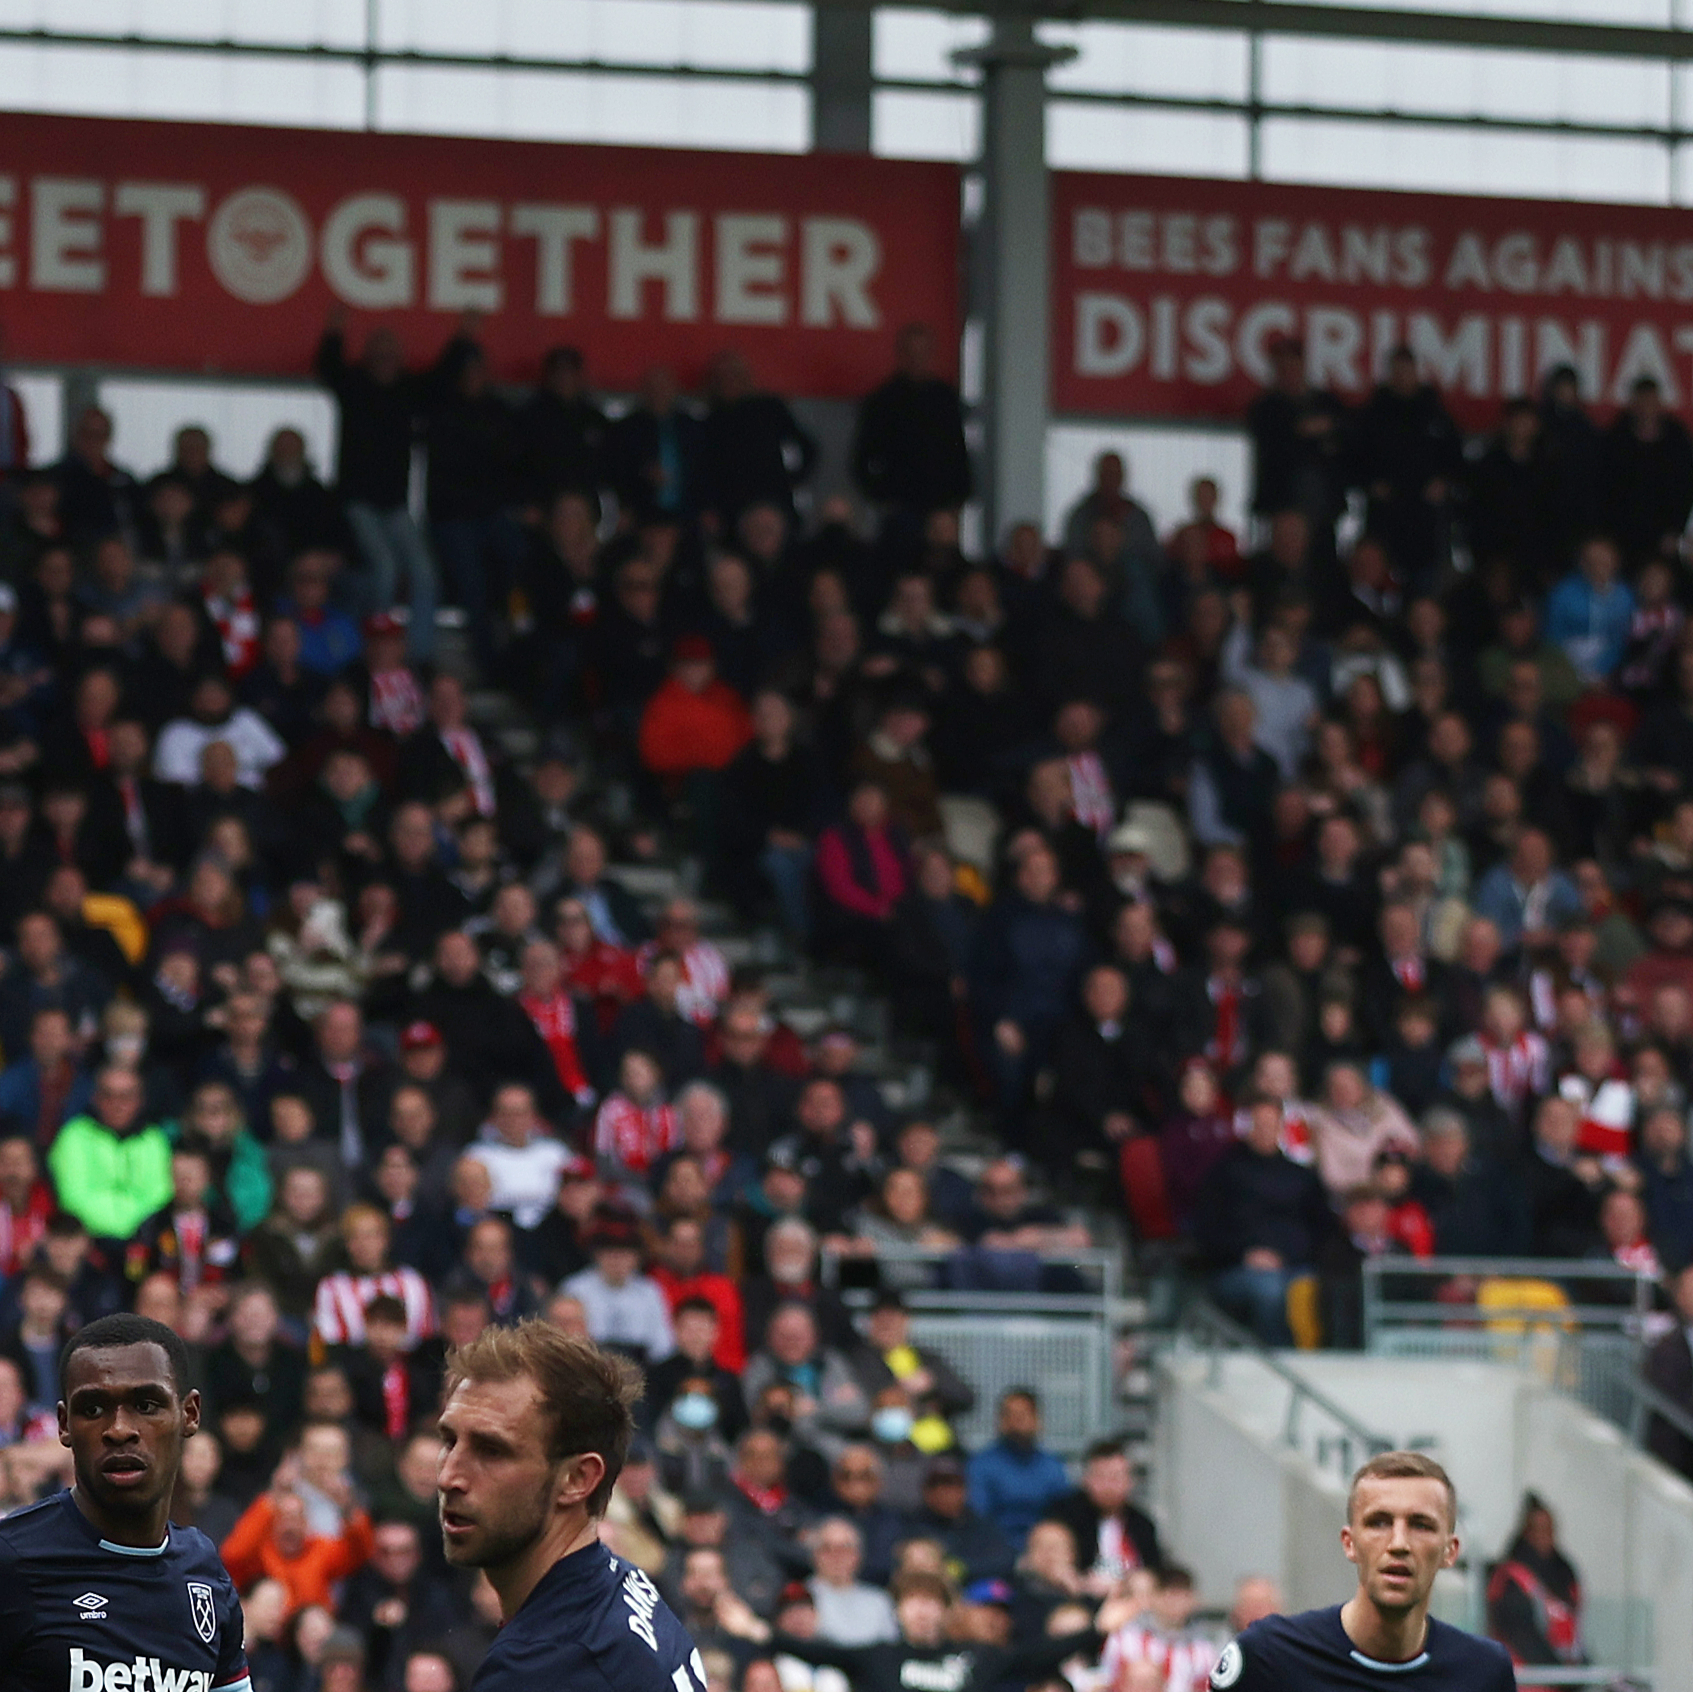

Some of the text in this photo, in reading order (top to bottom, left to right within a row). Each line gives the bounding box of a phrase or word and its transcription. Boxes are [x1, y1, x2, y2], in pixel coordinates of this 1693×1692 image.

[1072, 206, 1240, 279] BEES
[1252, 215, 1432, 290] FANS
[79, 1610, 107, 1620] umbro
